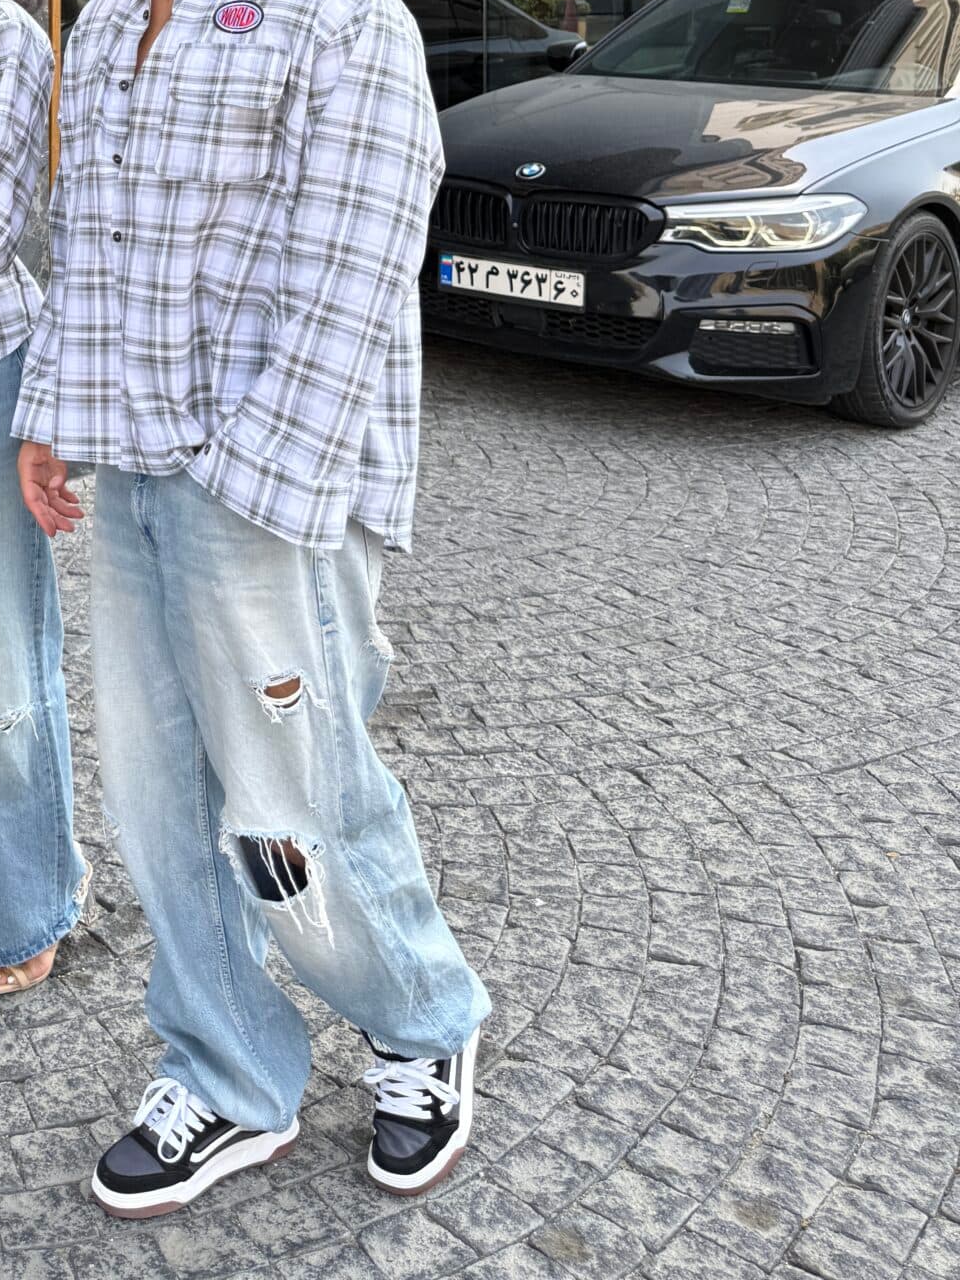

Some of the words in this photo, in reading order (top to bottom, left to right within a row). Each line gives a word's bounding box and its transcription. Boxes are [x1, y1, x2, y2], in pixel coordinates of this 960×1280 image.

[220, 5, 255, 27] WORLD
[455, 261, 479, 287] ۴۲
[486, 265, 499, 288] م
[506, 268, 548, 297] ۳۶۳
[553, 280, 579, 301] ۶۰
